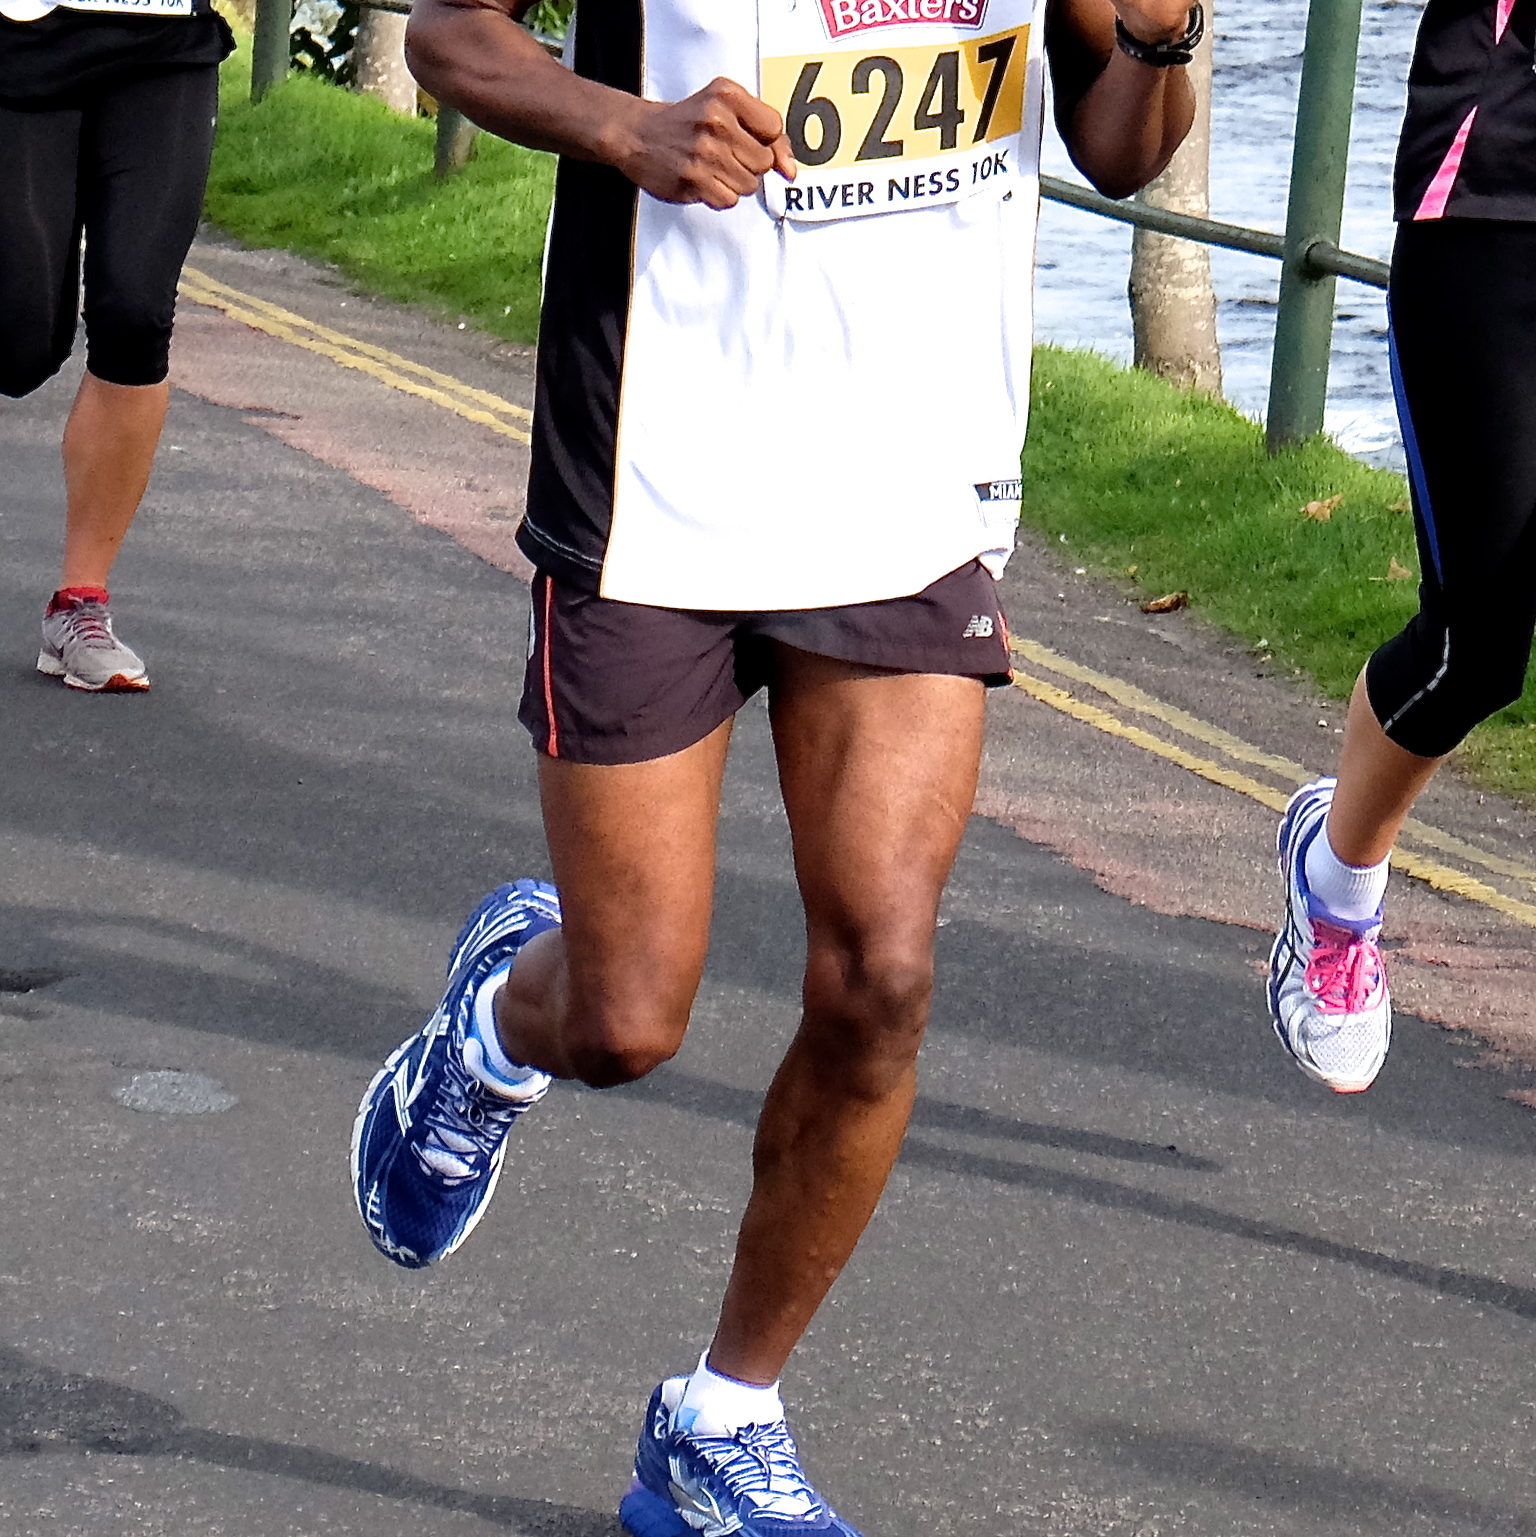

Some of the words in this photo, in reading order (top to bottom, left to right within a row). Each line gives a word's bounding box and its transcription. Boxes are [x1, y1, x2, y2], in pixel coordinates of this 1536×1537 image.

[785, 35, 1018, 167] 6247
[784, 182, 874, 212] RIVER
[888, 168, 960, 202] NESS
[972, 150, 1009, 185] 10K
